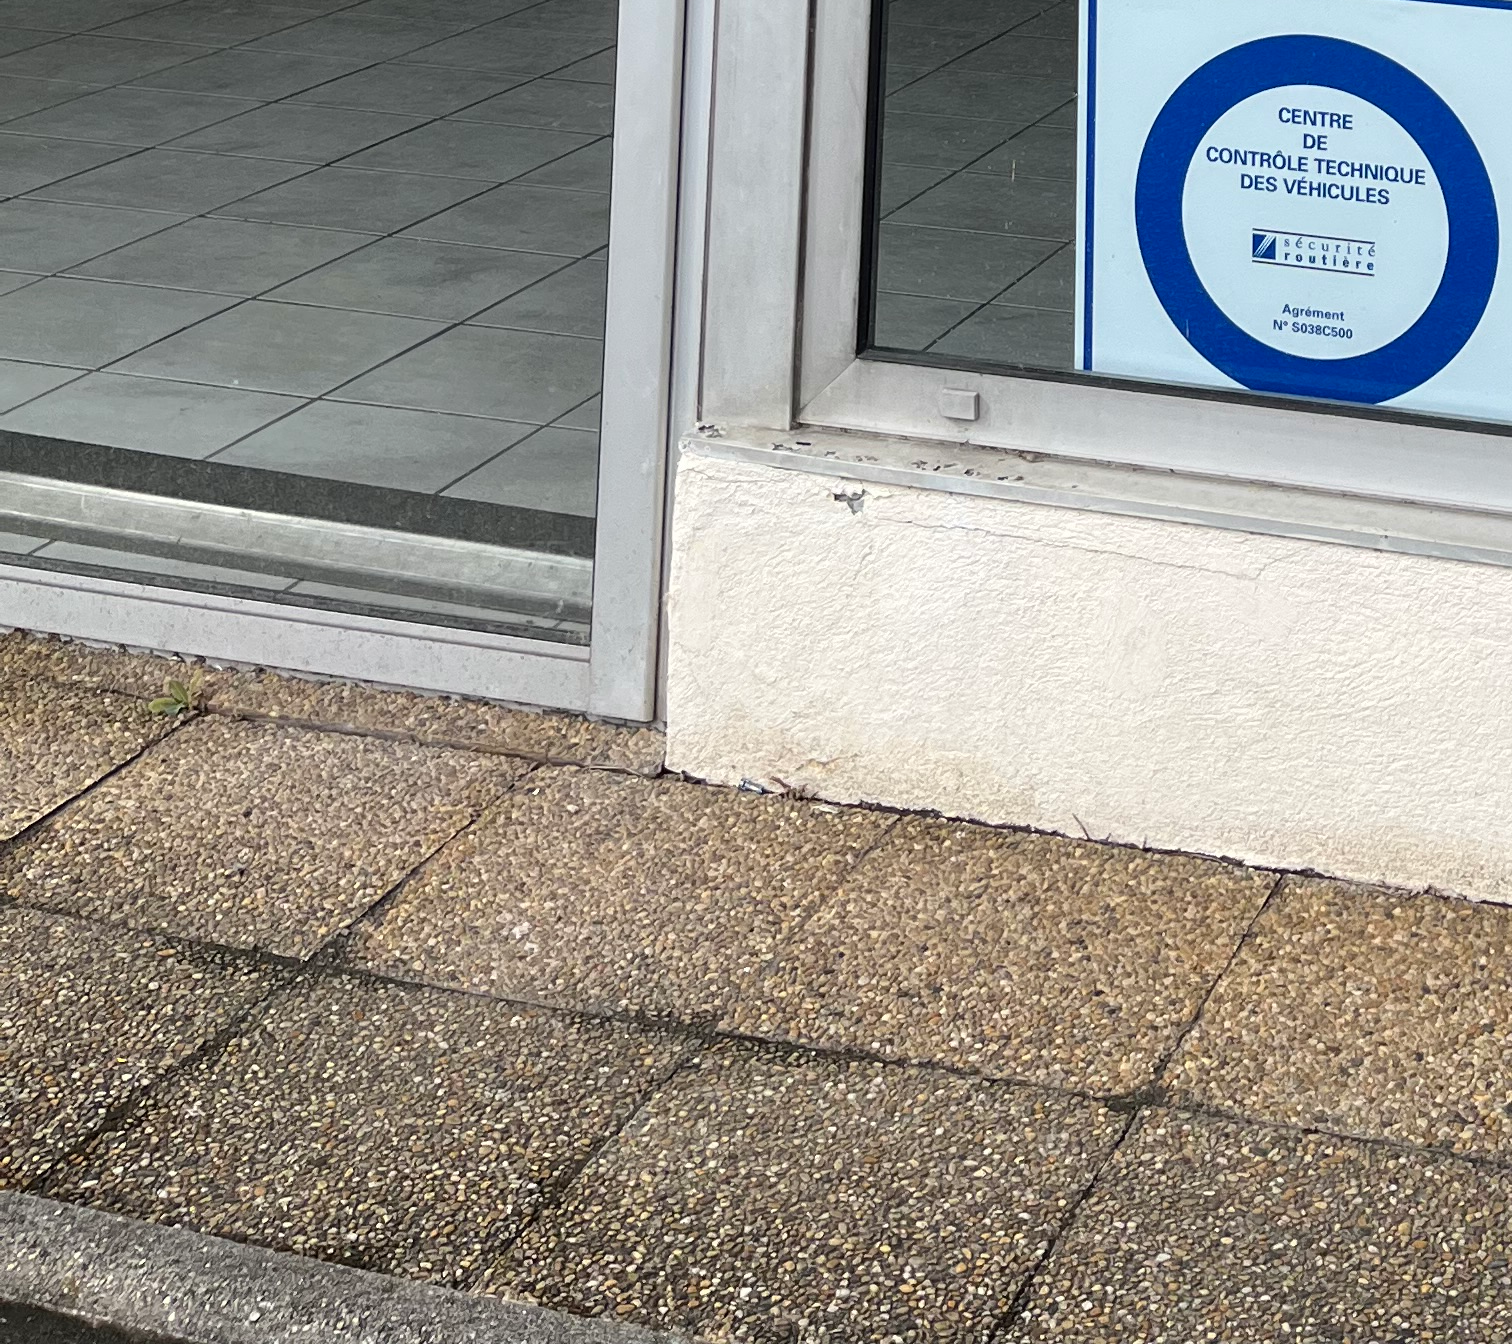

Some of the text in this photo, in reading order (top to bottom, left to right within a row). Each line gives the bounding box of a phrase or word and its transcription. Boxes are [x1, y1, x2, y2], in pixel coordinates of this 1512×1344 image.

[1278, 106, 1353, 131] CENTRE
[1302, 133, 1328, 151] DE
[1206, 145, 1427, 187] CONTRÔLE TECHNIQUE
[1240, 173, 1390, 205] DES VÉHICULES
[1284, 236, 1376, 257] sécurité
[1284, 252, 1375, 271] routière
[1282, 303, 1345, 322] Agrément
[1273, 318, 1353, 340] N° S038C500
